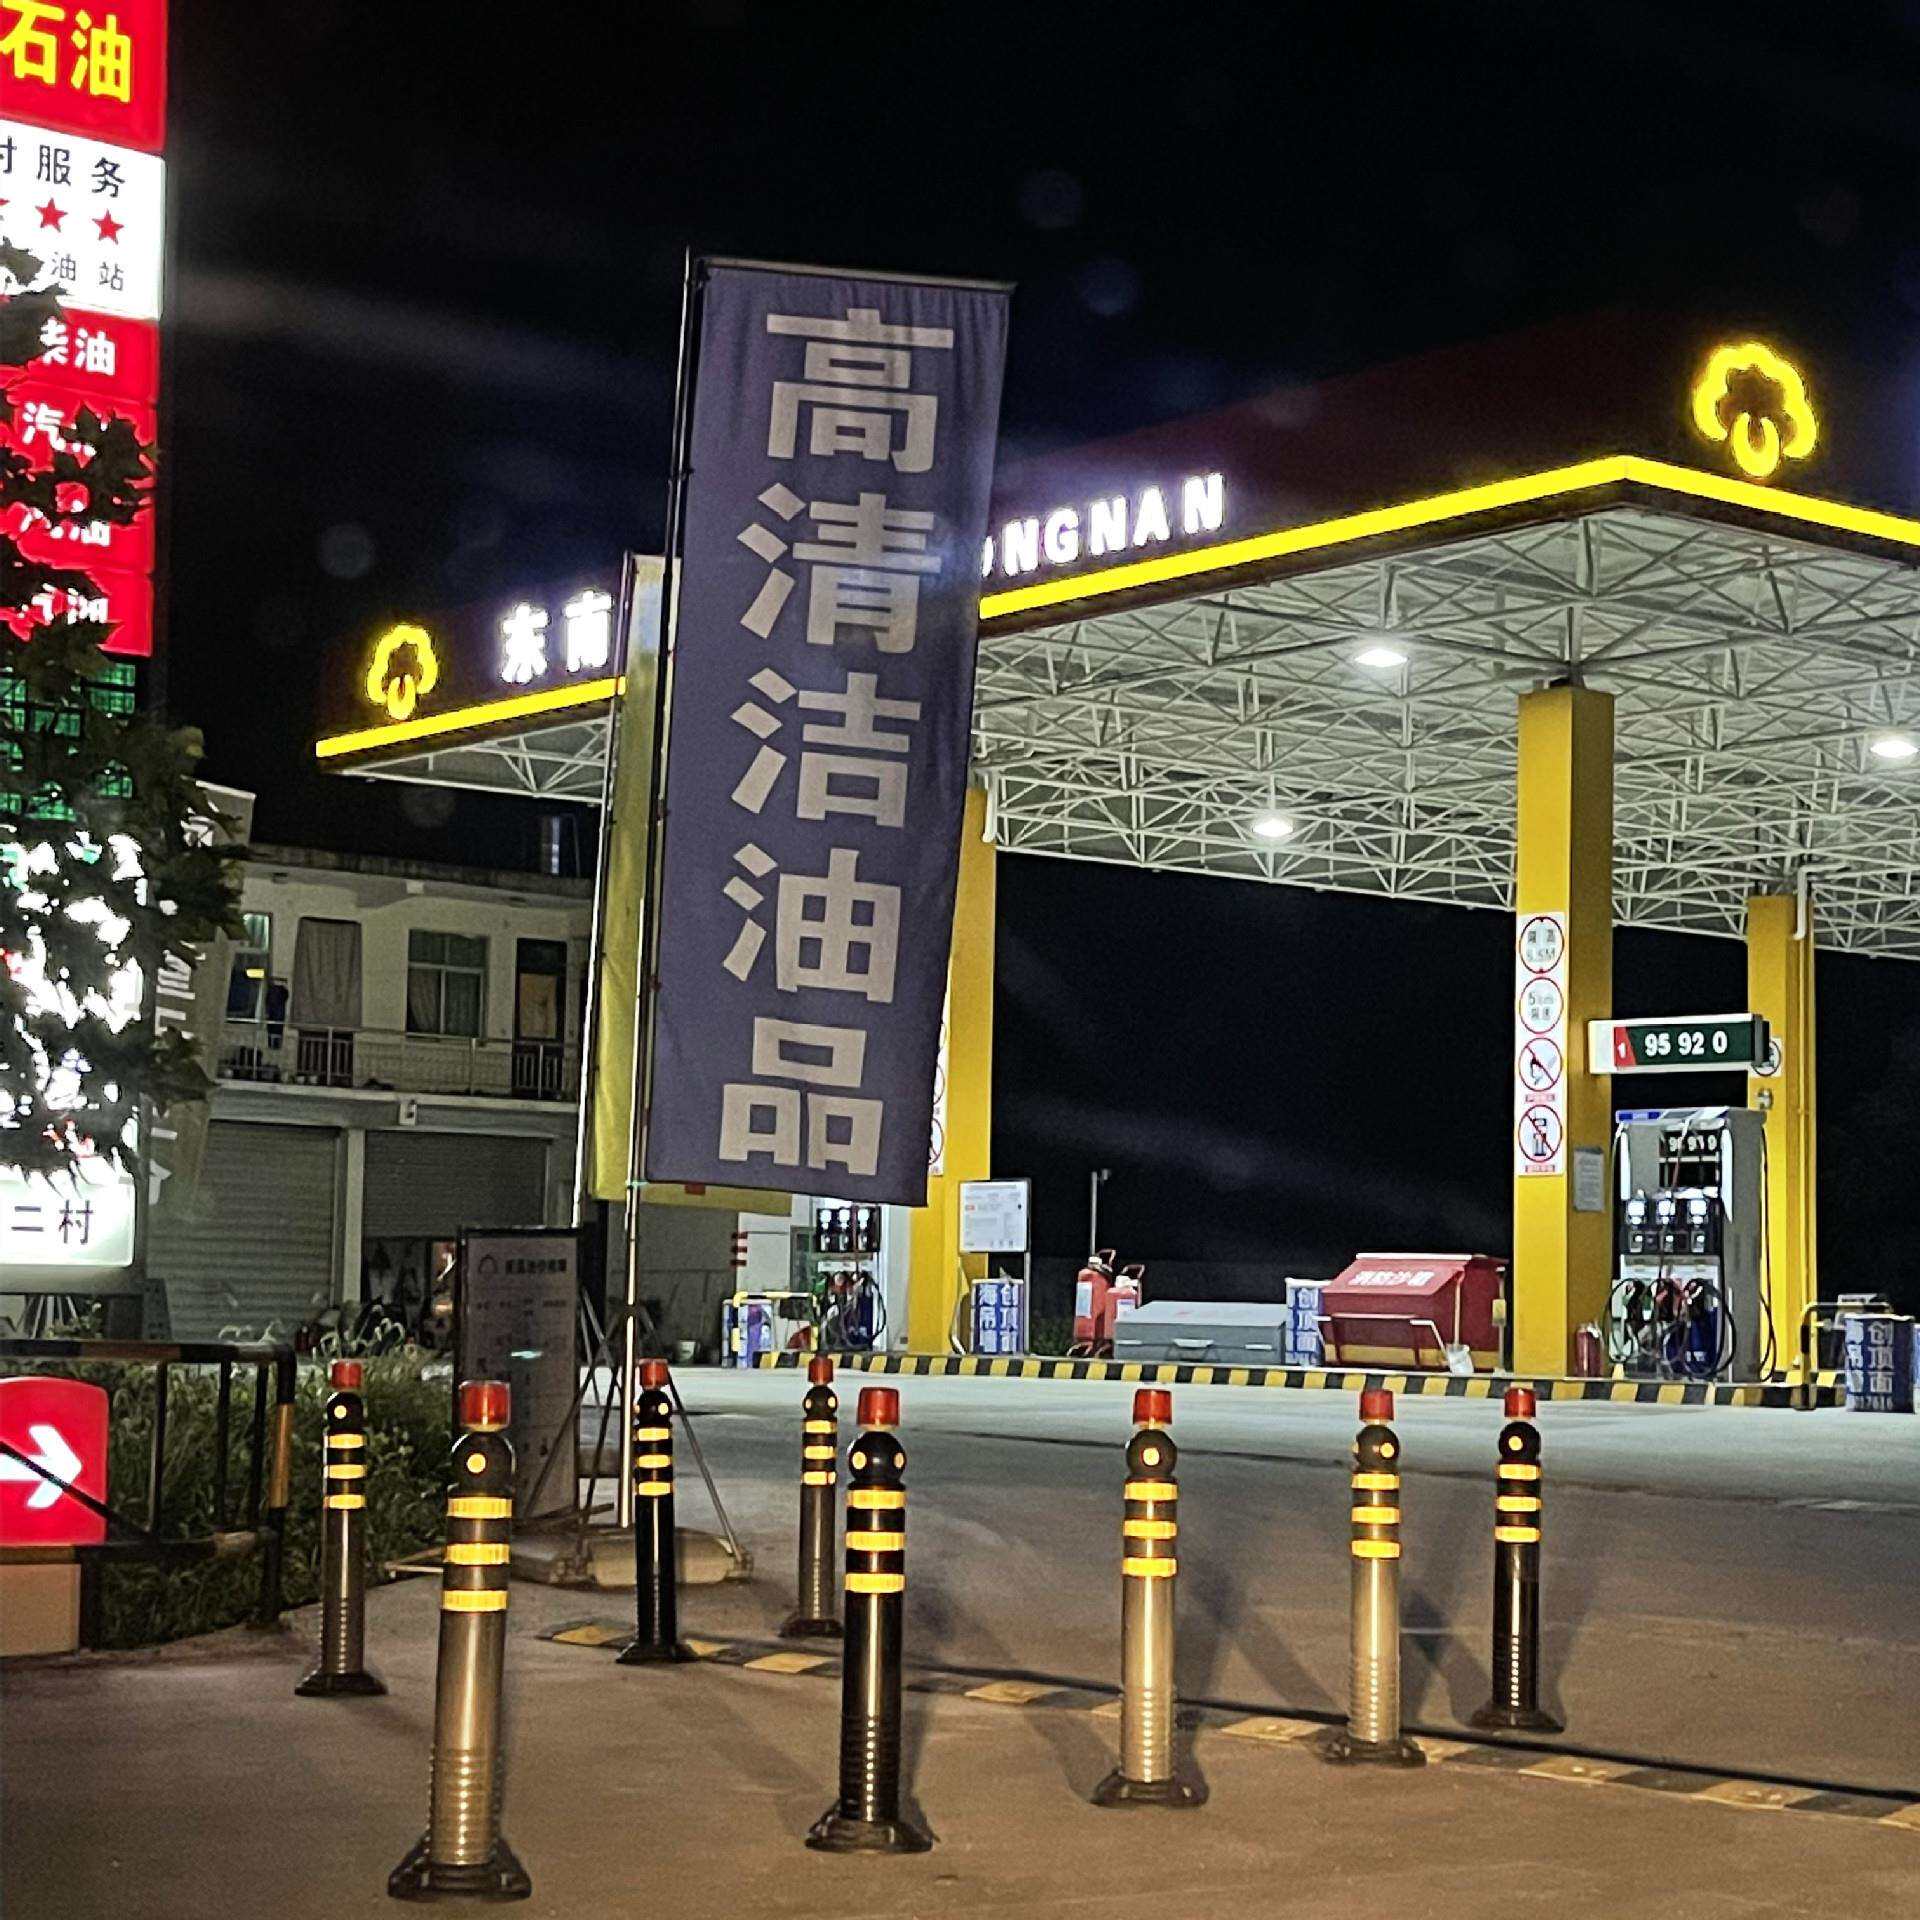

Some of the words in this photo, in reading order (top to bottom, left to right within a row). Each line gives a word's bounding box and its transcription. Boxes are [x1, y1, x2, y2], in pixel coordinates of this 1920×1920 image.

[501, 590, 613, 684] 东南
[720, 308, 954, 1175] 高清洁油品
[1644, 1032, 1672, 1056] 95
[1677, 1031, 1705, 1056] 92
[1711, 1030, 1728, 1054] 0
